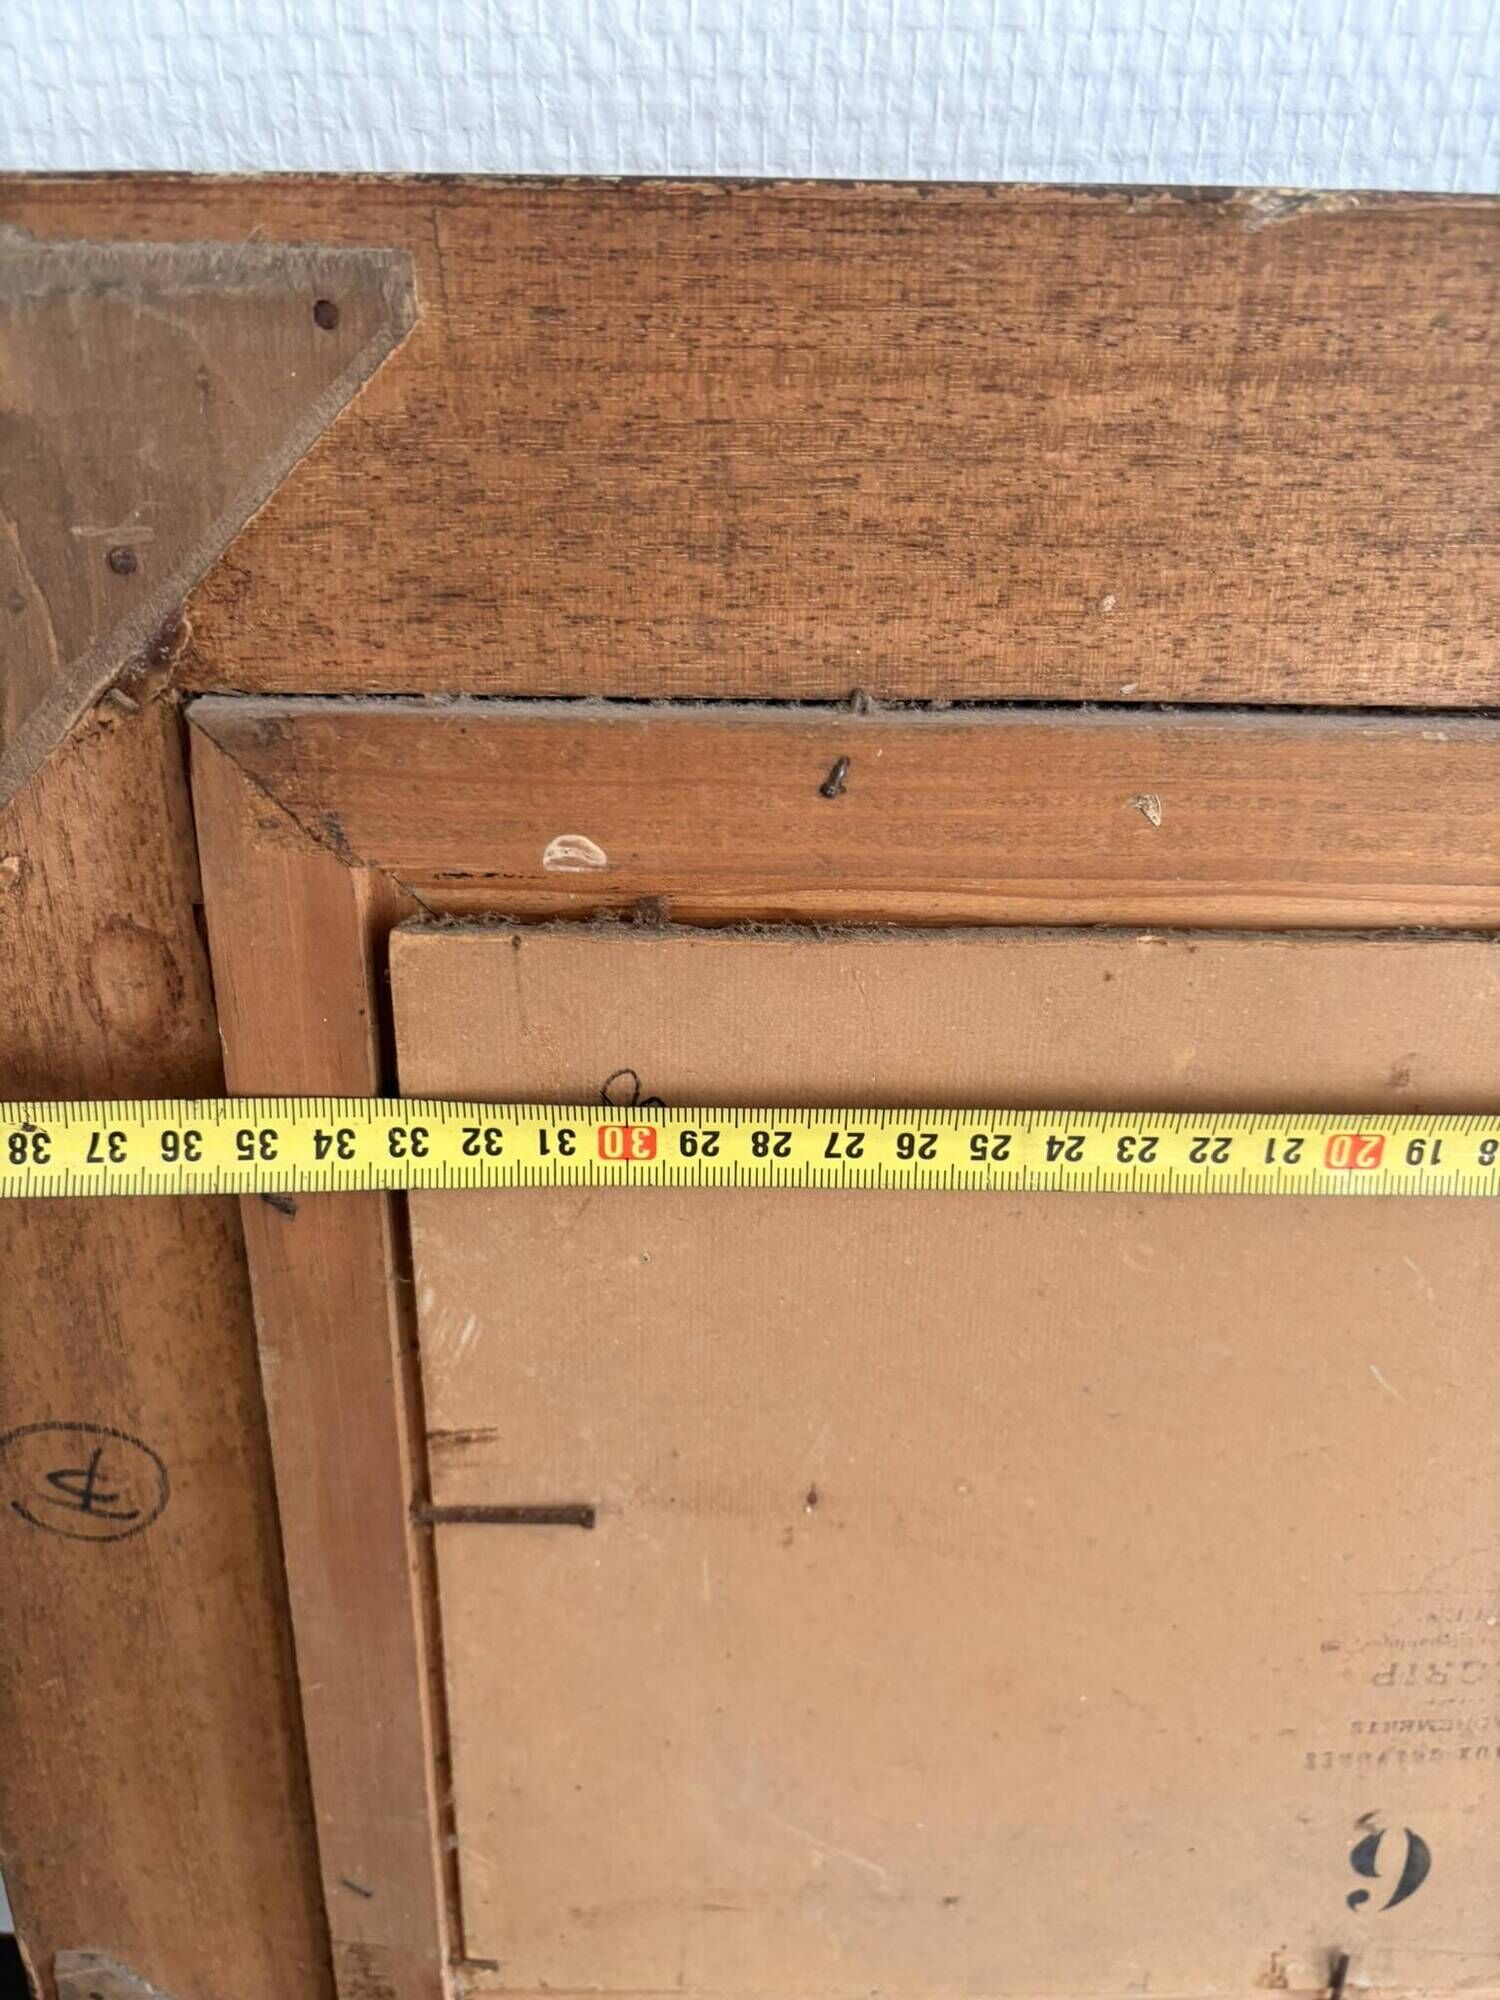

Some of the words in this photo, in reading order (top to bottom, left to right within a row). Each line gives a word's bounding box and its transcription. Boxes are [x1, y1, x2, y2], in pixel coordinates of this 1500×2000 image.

[8, 1132, 51, 1163] 38
[87, 1131, 127, 1163] 37
[161, 1130, 202, 1162] 36
[236, 1129, 278, 1161] 35
[313, 1127, 356, 1160] 34
[388, 1127, 429, 1158] 33
[462, 1127, 503, 1156] 32
[539, 1129, 576, 1156] 31
[604, 1126, 651, 1159] 30
[679, 1130, 720, 1158] 29
[751, 1131, 792, 1158] 28
[824, 1132, 865, 1159] 27
[896, 1132, 938, 1160] 26
[970, 1134, 1012, 1161] 25
[1046, 1135, 1086, 1162] 24
[1117, 1136, 1159, 1163] 23
[1189, 1137, 1233, 1164] 22
[1266, 1138, 1304, 1164] 21
[1328, 1136, 1376, 1168] 20
[1407, 1139, 1442, 1166] 19
[1478, 1138, 1499, 1166] 8
[1346, 1827, 1432, 1912] 6
